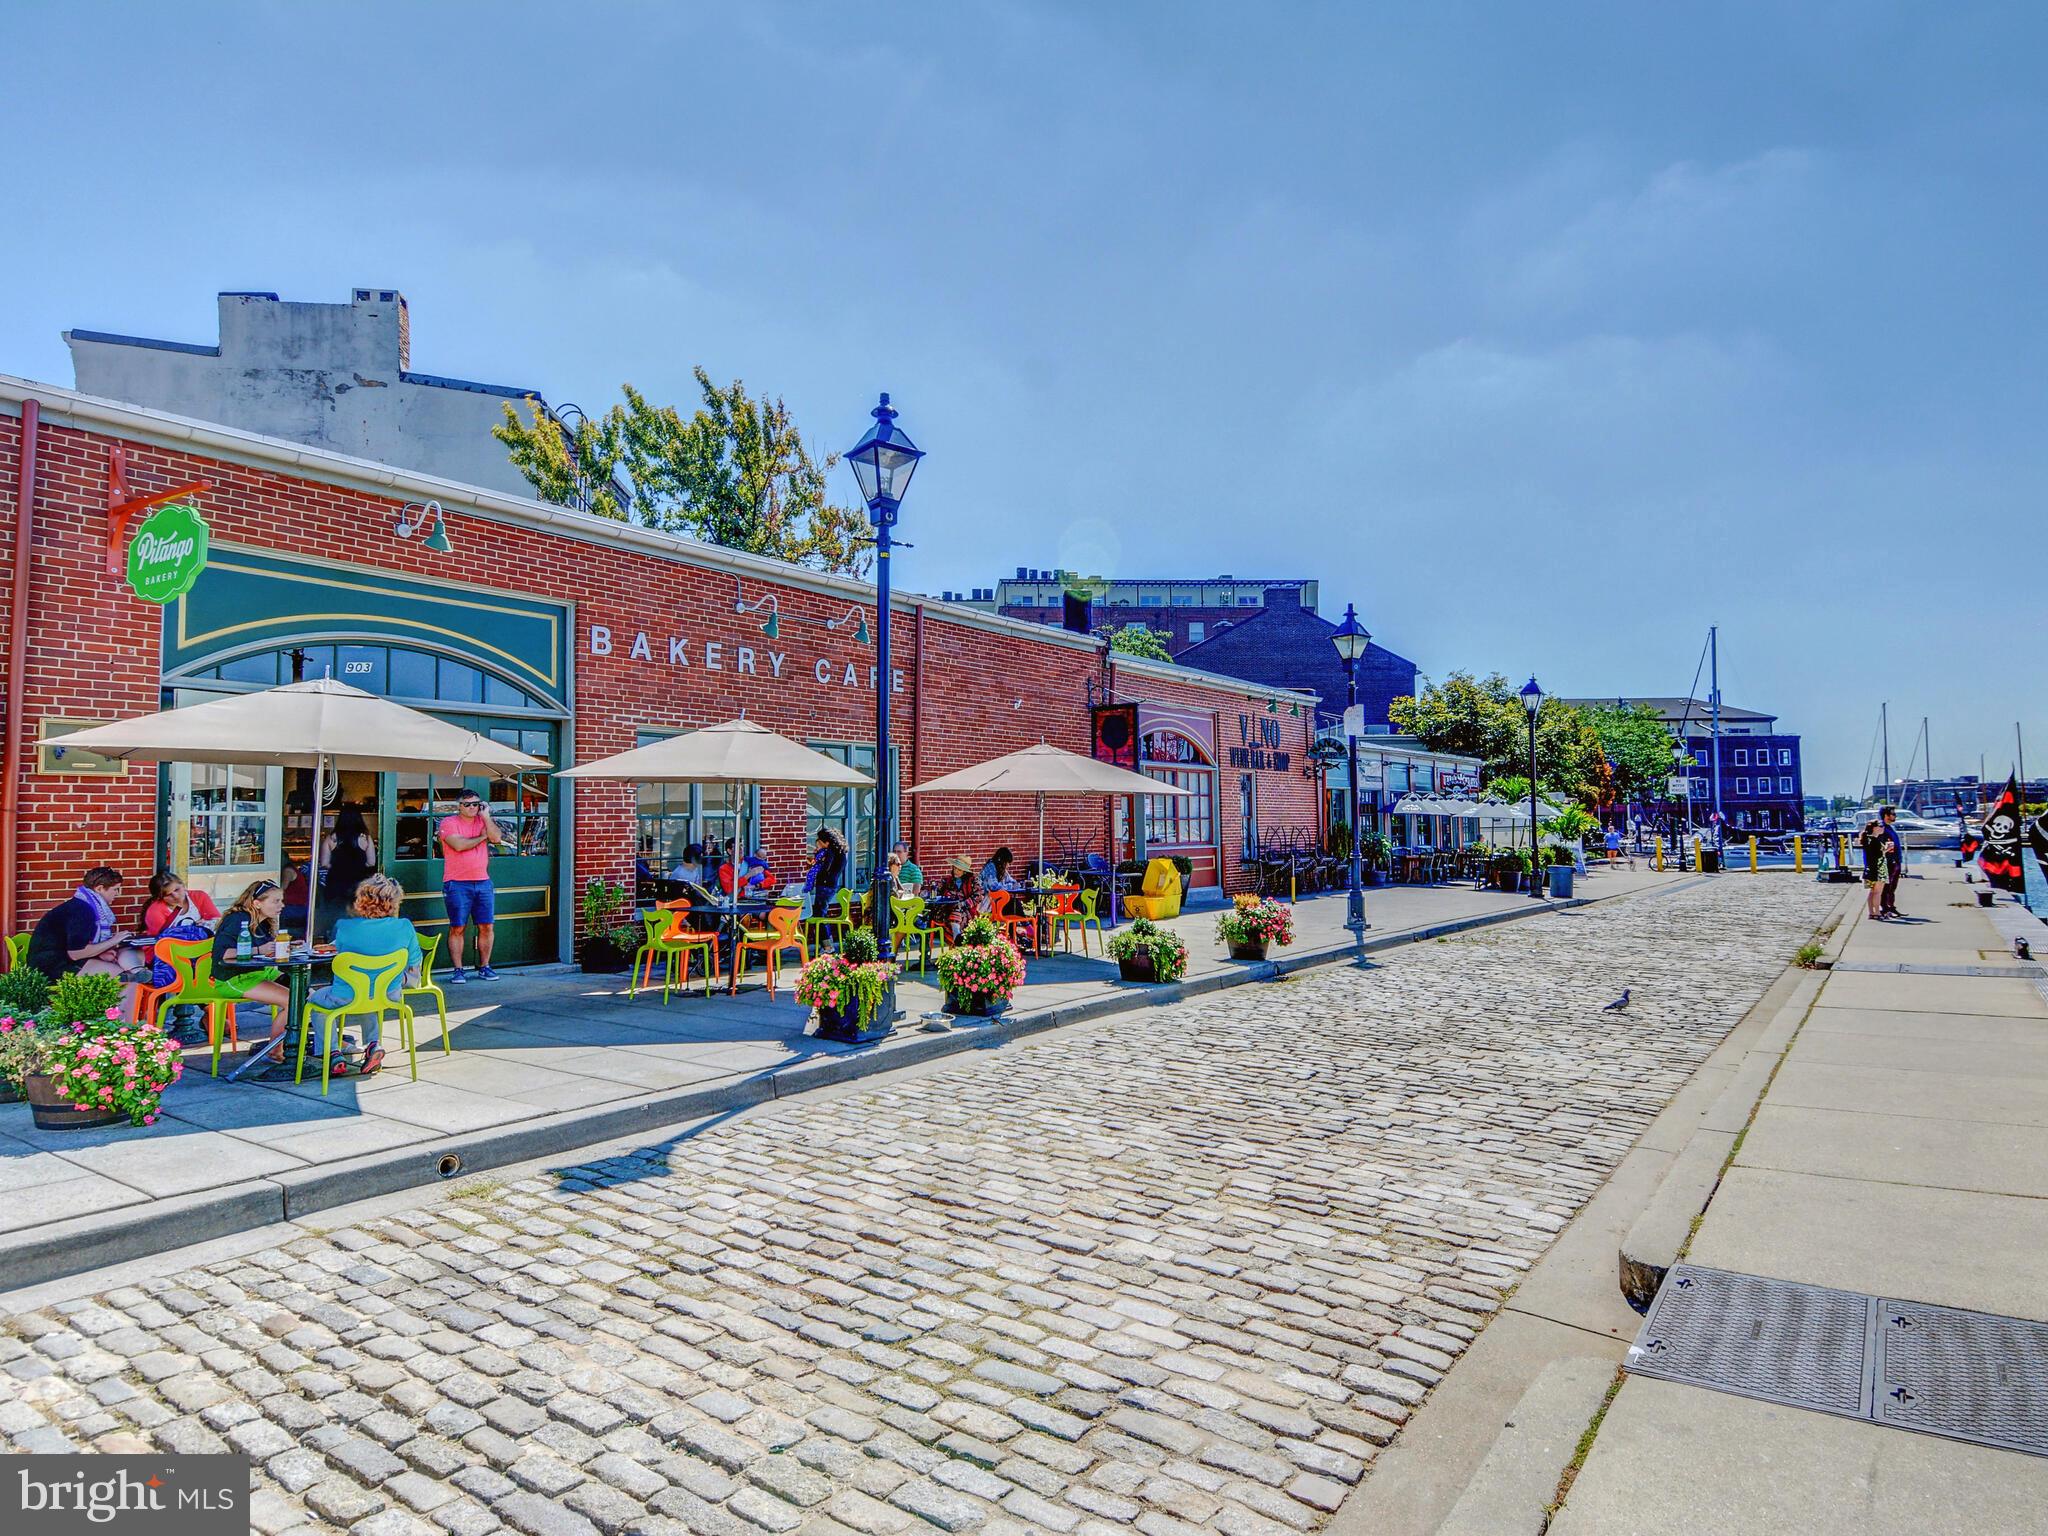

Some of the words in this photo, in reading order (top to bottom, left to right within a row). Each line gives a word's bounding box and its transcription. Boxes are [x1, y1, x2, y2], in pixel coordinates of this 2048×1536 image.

[137, 531, 194, 570] Pitango
[145, 571, 178, 586] BAKERY
[347, 662, 371, 673] 903
[590, 625, 785, 678] BAKERY
[814, 657, 905, 693] CAFE
[1239, 711, 1281, 749] VINO
